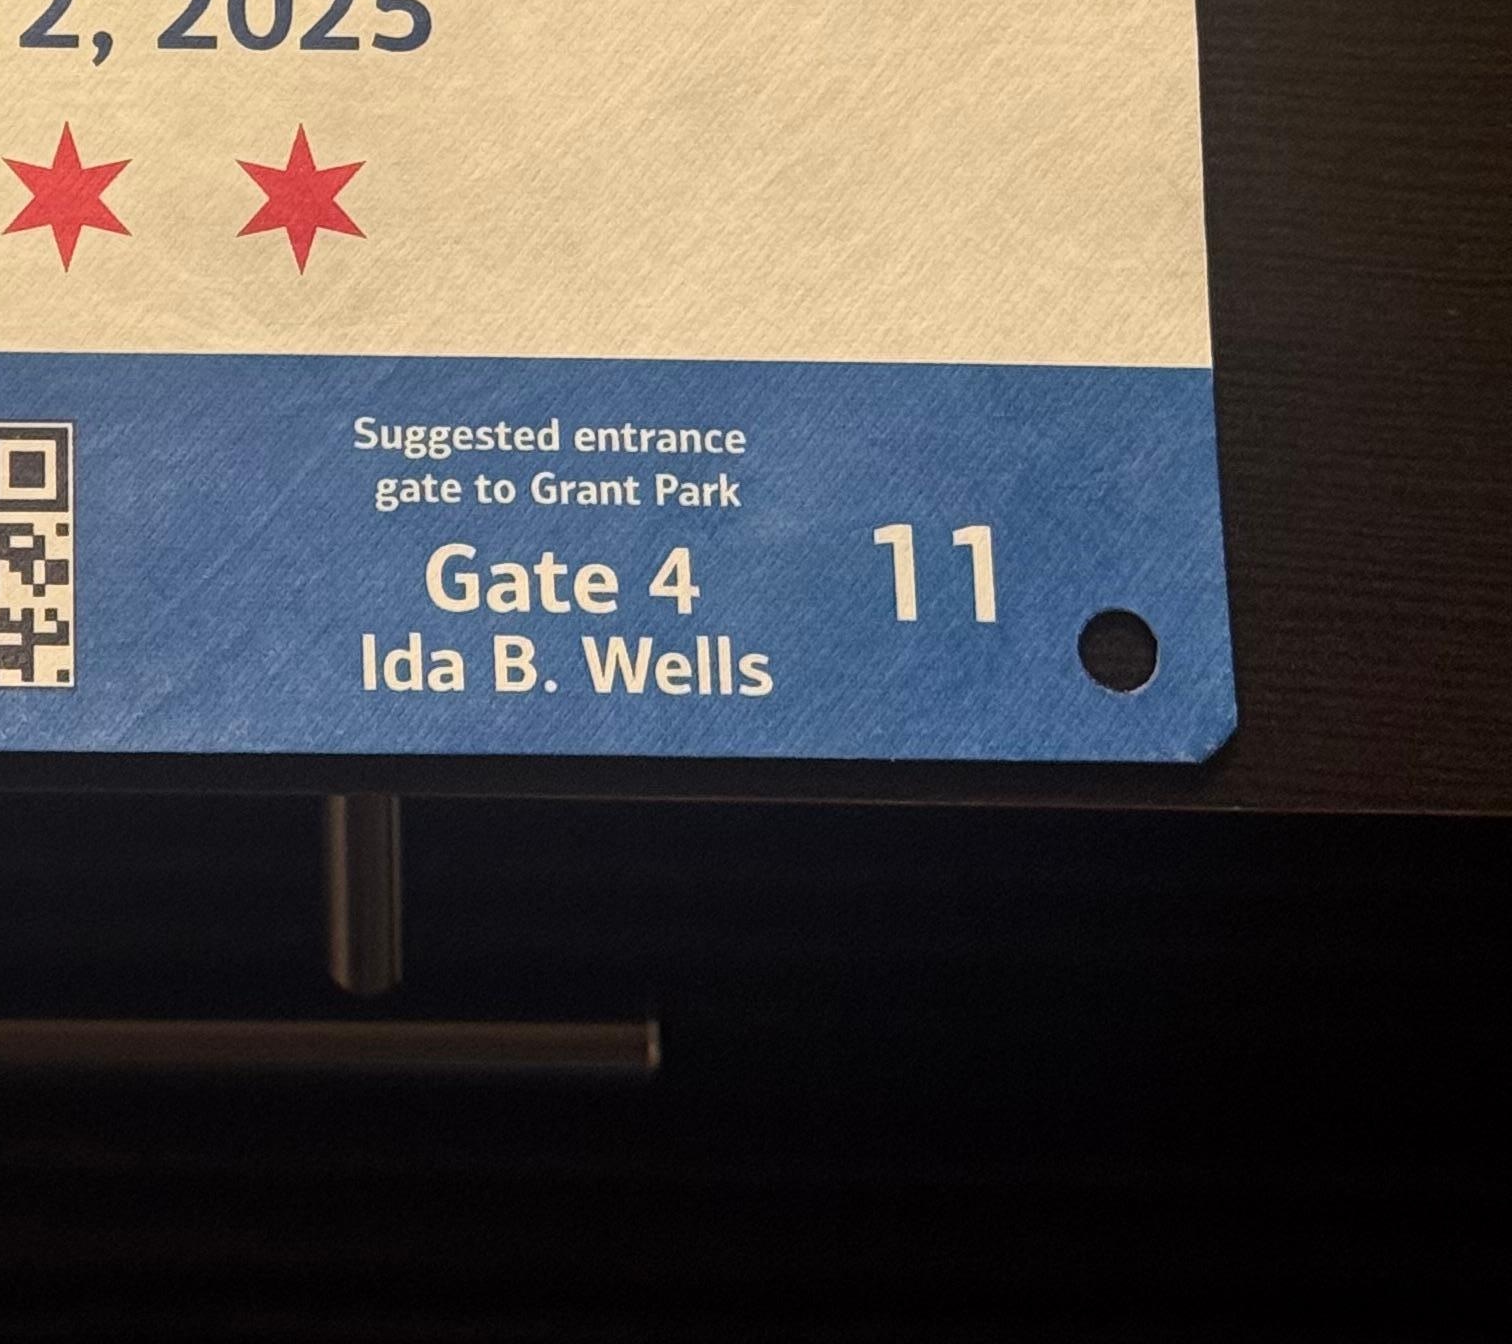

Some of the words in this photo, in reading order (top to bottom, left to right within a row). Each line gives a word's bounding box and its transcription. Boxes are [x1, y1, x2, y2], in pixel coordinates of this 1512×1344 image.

[354, 416, 560, 460] Suggested
[574, 422, 747, 454] entrance
[375, 473, 462, 512] gate
[473, 474, 517, 504] to
[530, 471, 641, 506] Grant
[655, 472, 742, 507] Park
[425, 543, 619, 614] Gate
[648, 547, 701, 615] 4
[873, 523, 996, 623] 11
[362, 632, 465, 692] Ida
[493, 634, 558, 693] B.
[581, 635, 774, 697] Wells
